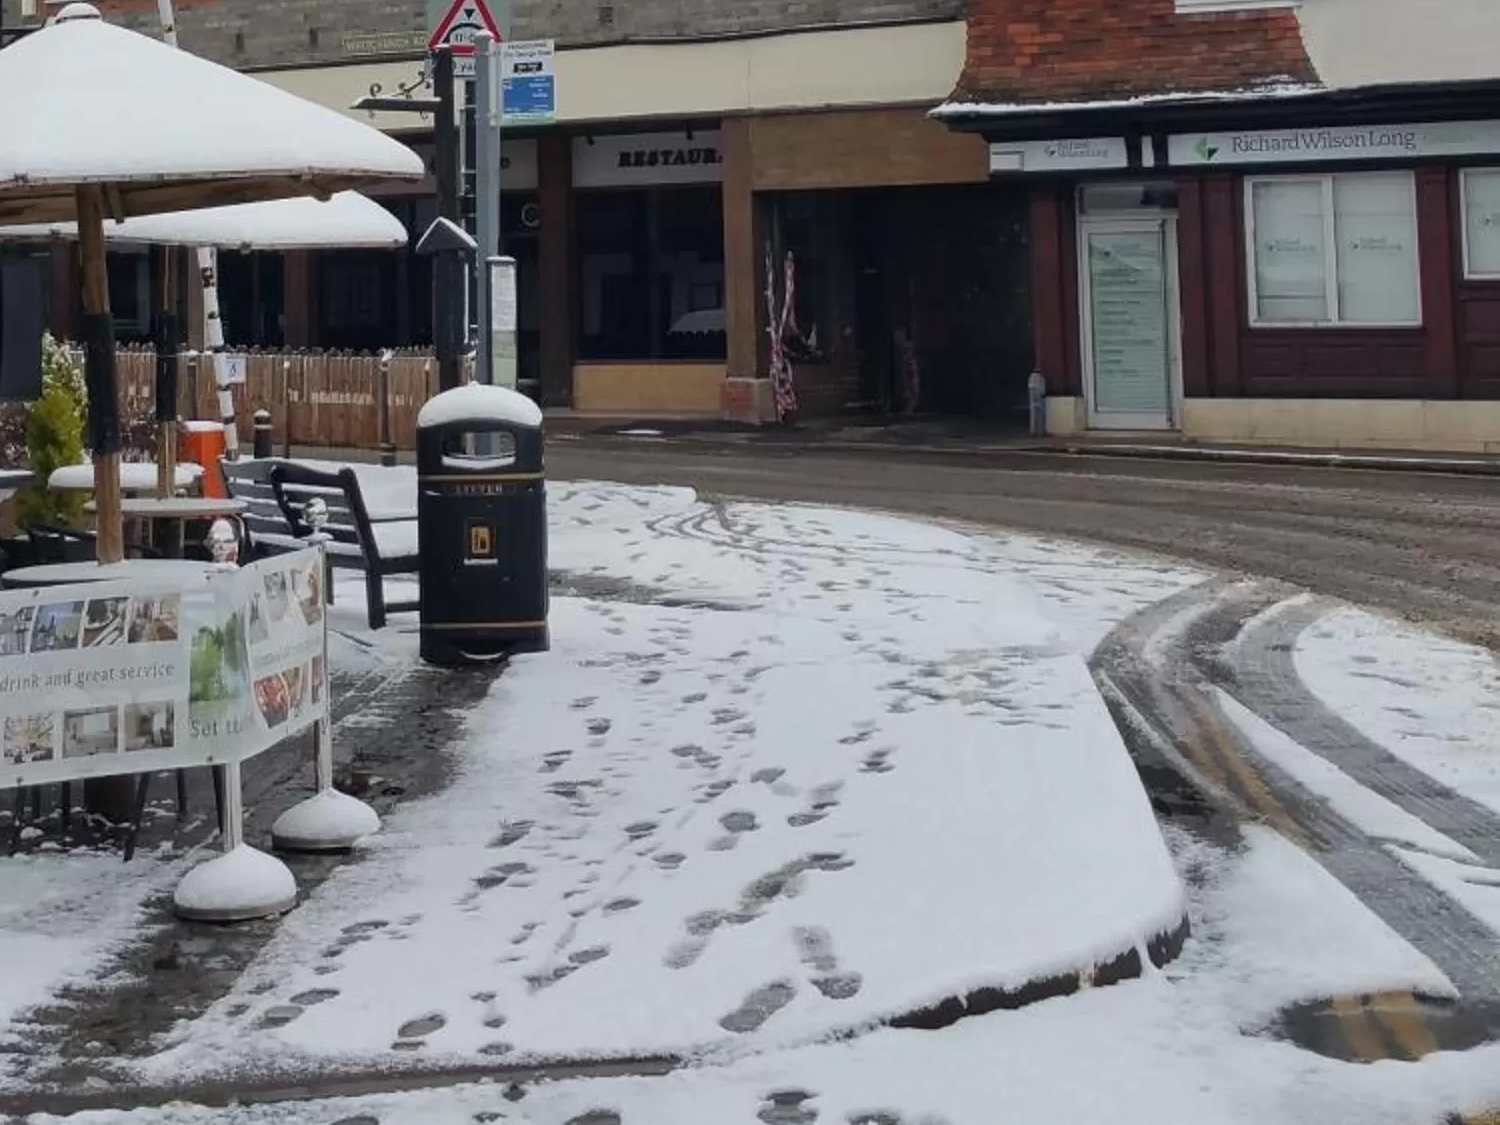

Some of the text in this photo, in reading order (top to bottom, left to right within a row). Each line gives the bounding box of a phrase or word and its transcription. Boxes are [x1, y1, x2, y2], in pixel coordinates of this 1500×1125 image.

[617, 148, 723, 168] RESTAUR
[0, 675, 41, 693] drink
[45, 671, 72, 688] and
[77, 666, 114, 687] great
[119, 662, 176, 680] service
